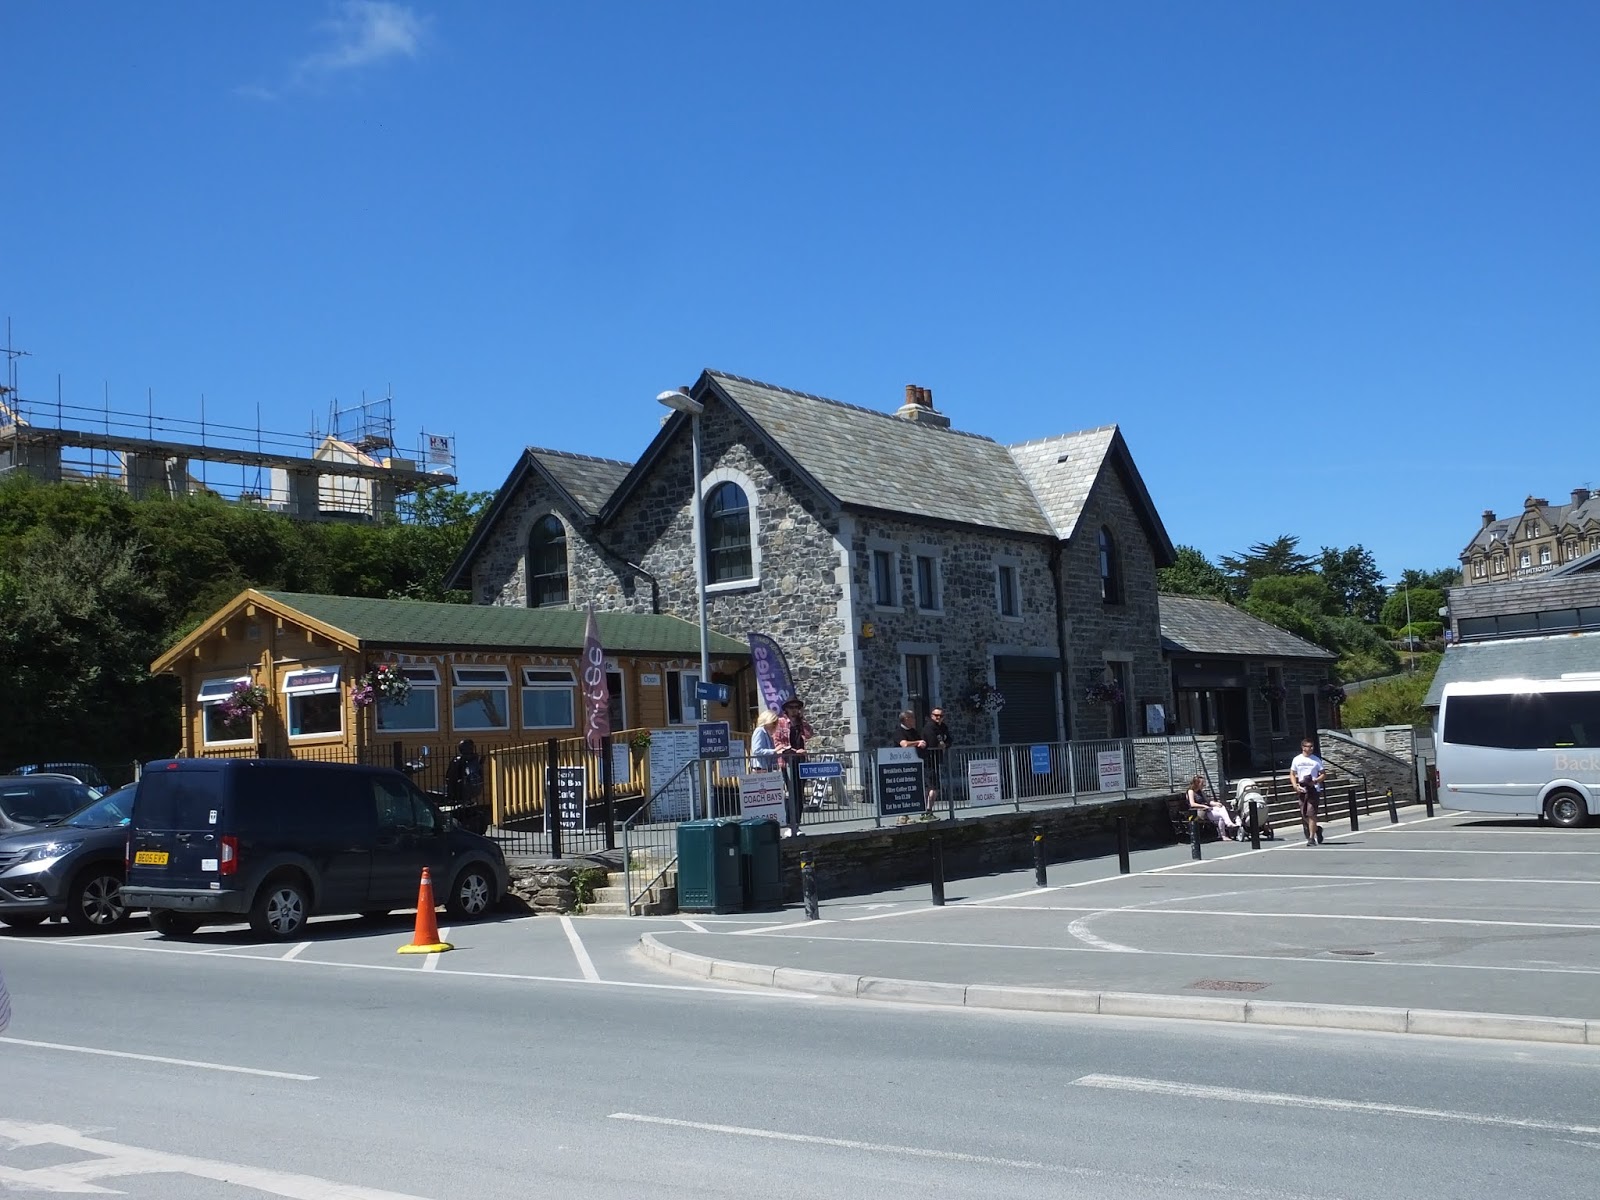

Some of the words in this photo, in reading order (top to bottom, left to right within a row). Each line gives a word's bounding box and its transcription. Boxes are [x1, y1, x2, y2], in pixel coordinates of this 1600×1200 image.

[1526, 564, 1552, 575] METROPOLE
[643, 675, 657, 683] Open
[700, 745, 728, 753] DISPLAYED?
[1552, 753, 1600, 771] Back
[818, 766, 839, 774] HARBOUR
[971, 777, 987, 785] COACH
[743, 794, 766, 804] COACH
[766, 792, 783, 802] BAYS
